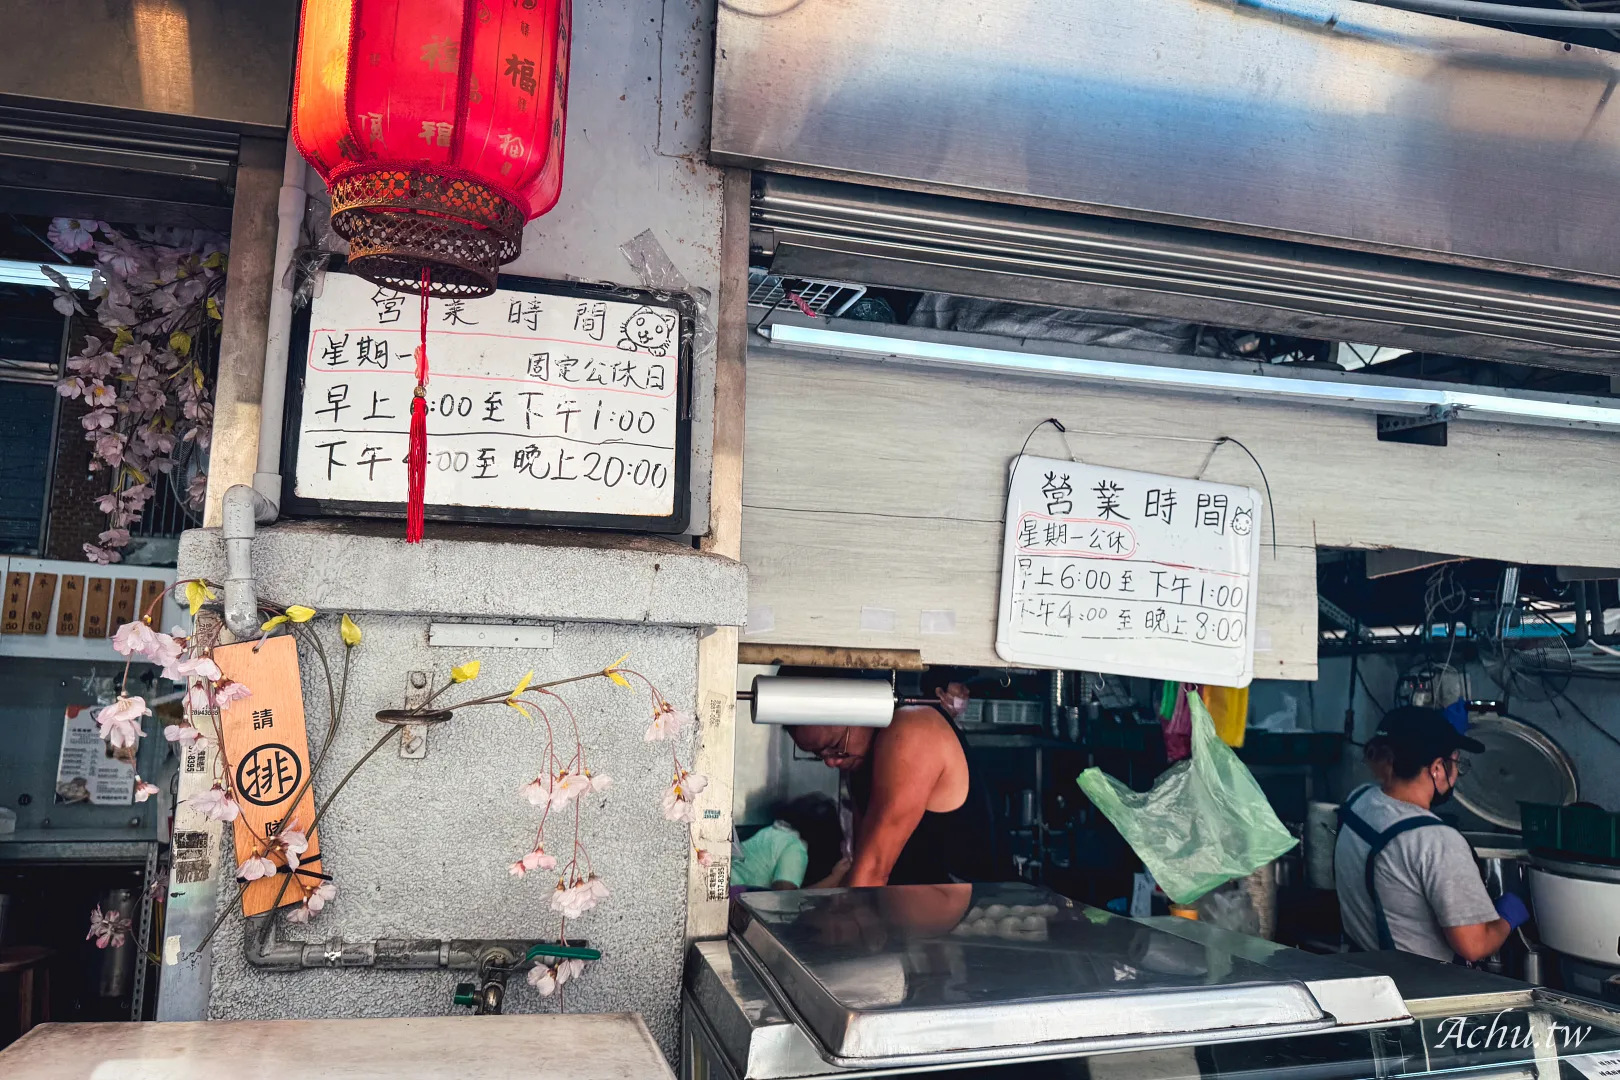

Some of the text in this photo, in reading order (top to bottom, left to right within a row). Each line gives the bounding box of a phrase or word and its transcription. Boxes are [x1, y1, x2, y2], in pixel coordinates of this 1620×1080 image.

[504, 54, 537, 96] 福
[321, 333, 666, 390] 星期一 固定公休日
[1041, 470, 1228, 536] 營業時間
[1018, 518, 1129, 554] 星期一公休
